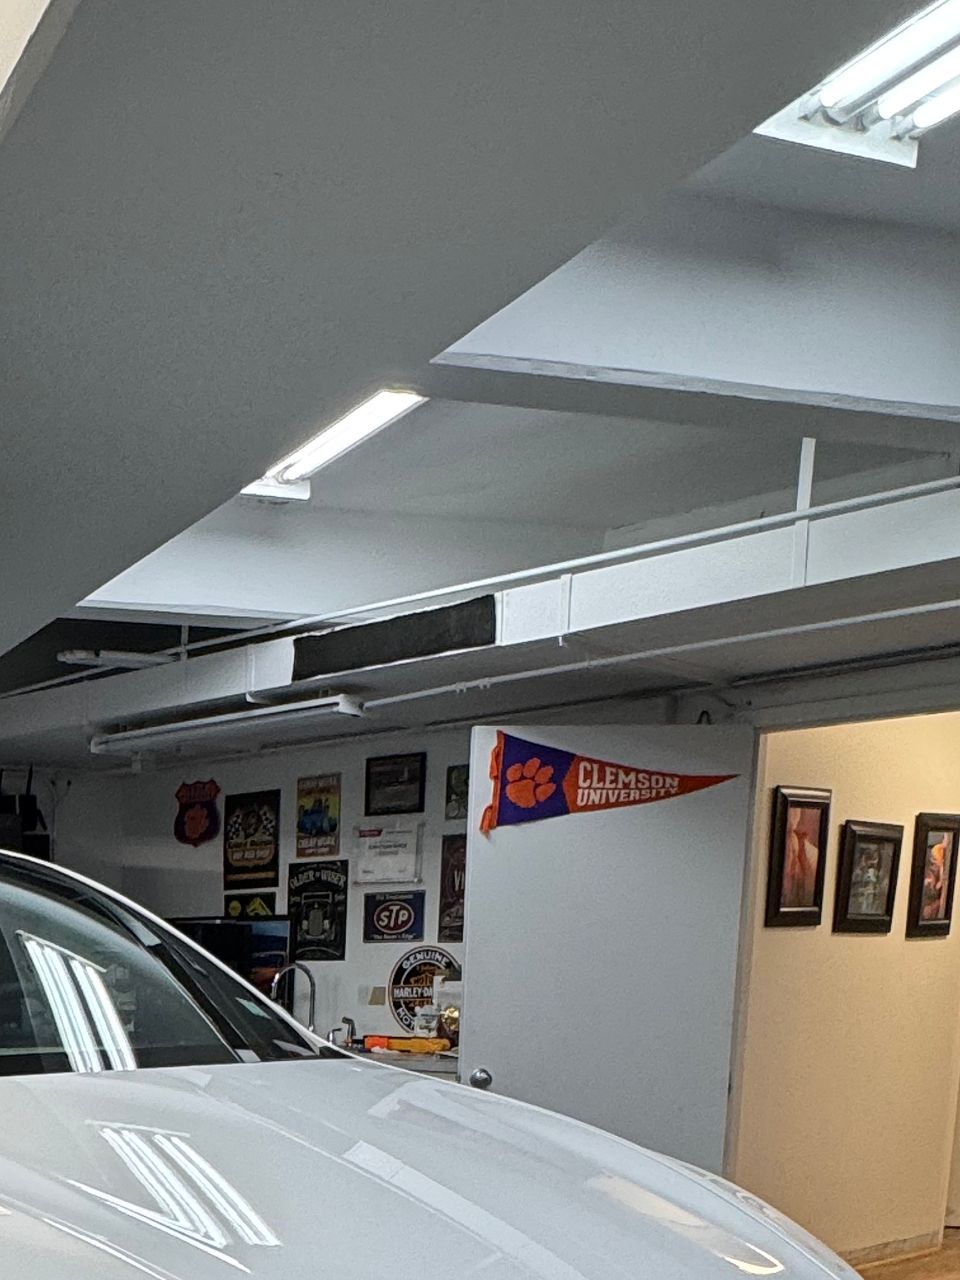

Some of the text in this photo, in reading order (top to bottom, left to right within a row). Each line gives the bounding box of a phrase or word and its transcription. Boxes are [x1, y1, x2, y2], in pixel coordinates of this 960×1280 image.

[578, 761, 680, 789] CLEMSON
[576, 786, 680, 806] UNIVERSITY
[290, 870, 315, 890] OLDER
[378, 905, 409, 928] STP
[402, 951, 450, 969] GENUINE
[393, 986, 433, 999] HARLEY-DA
